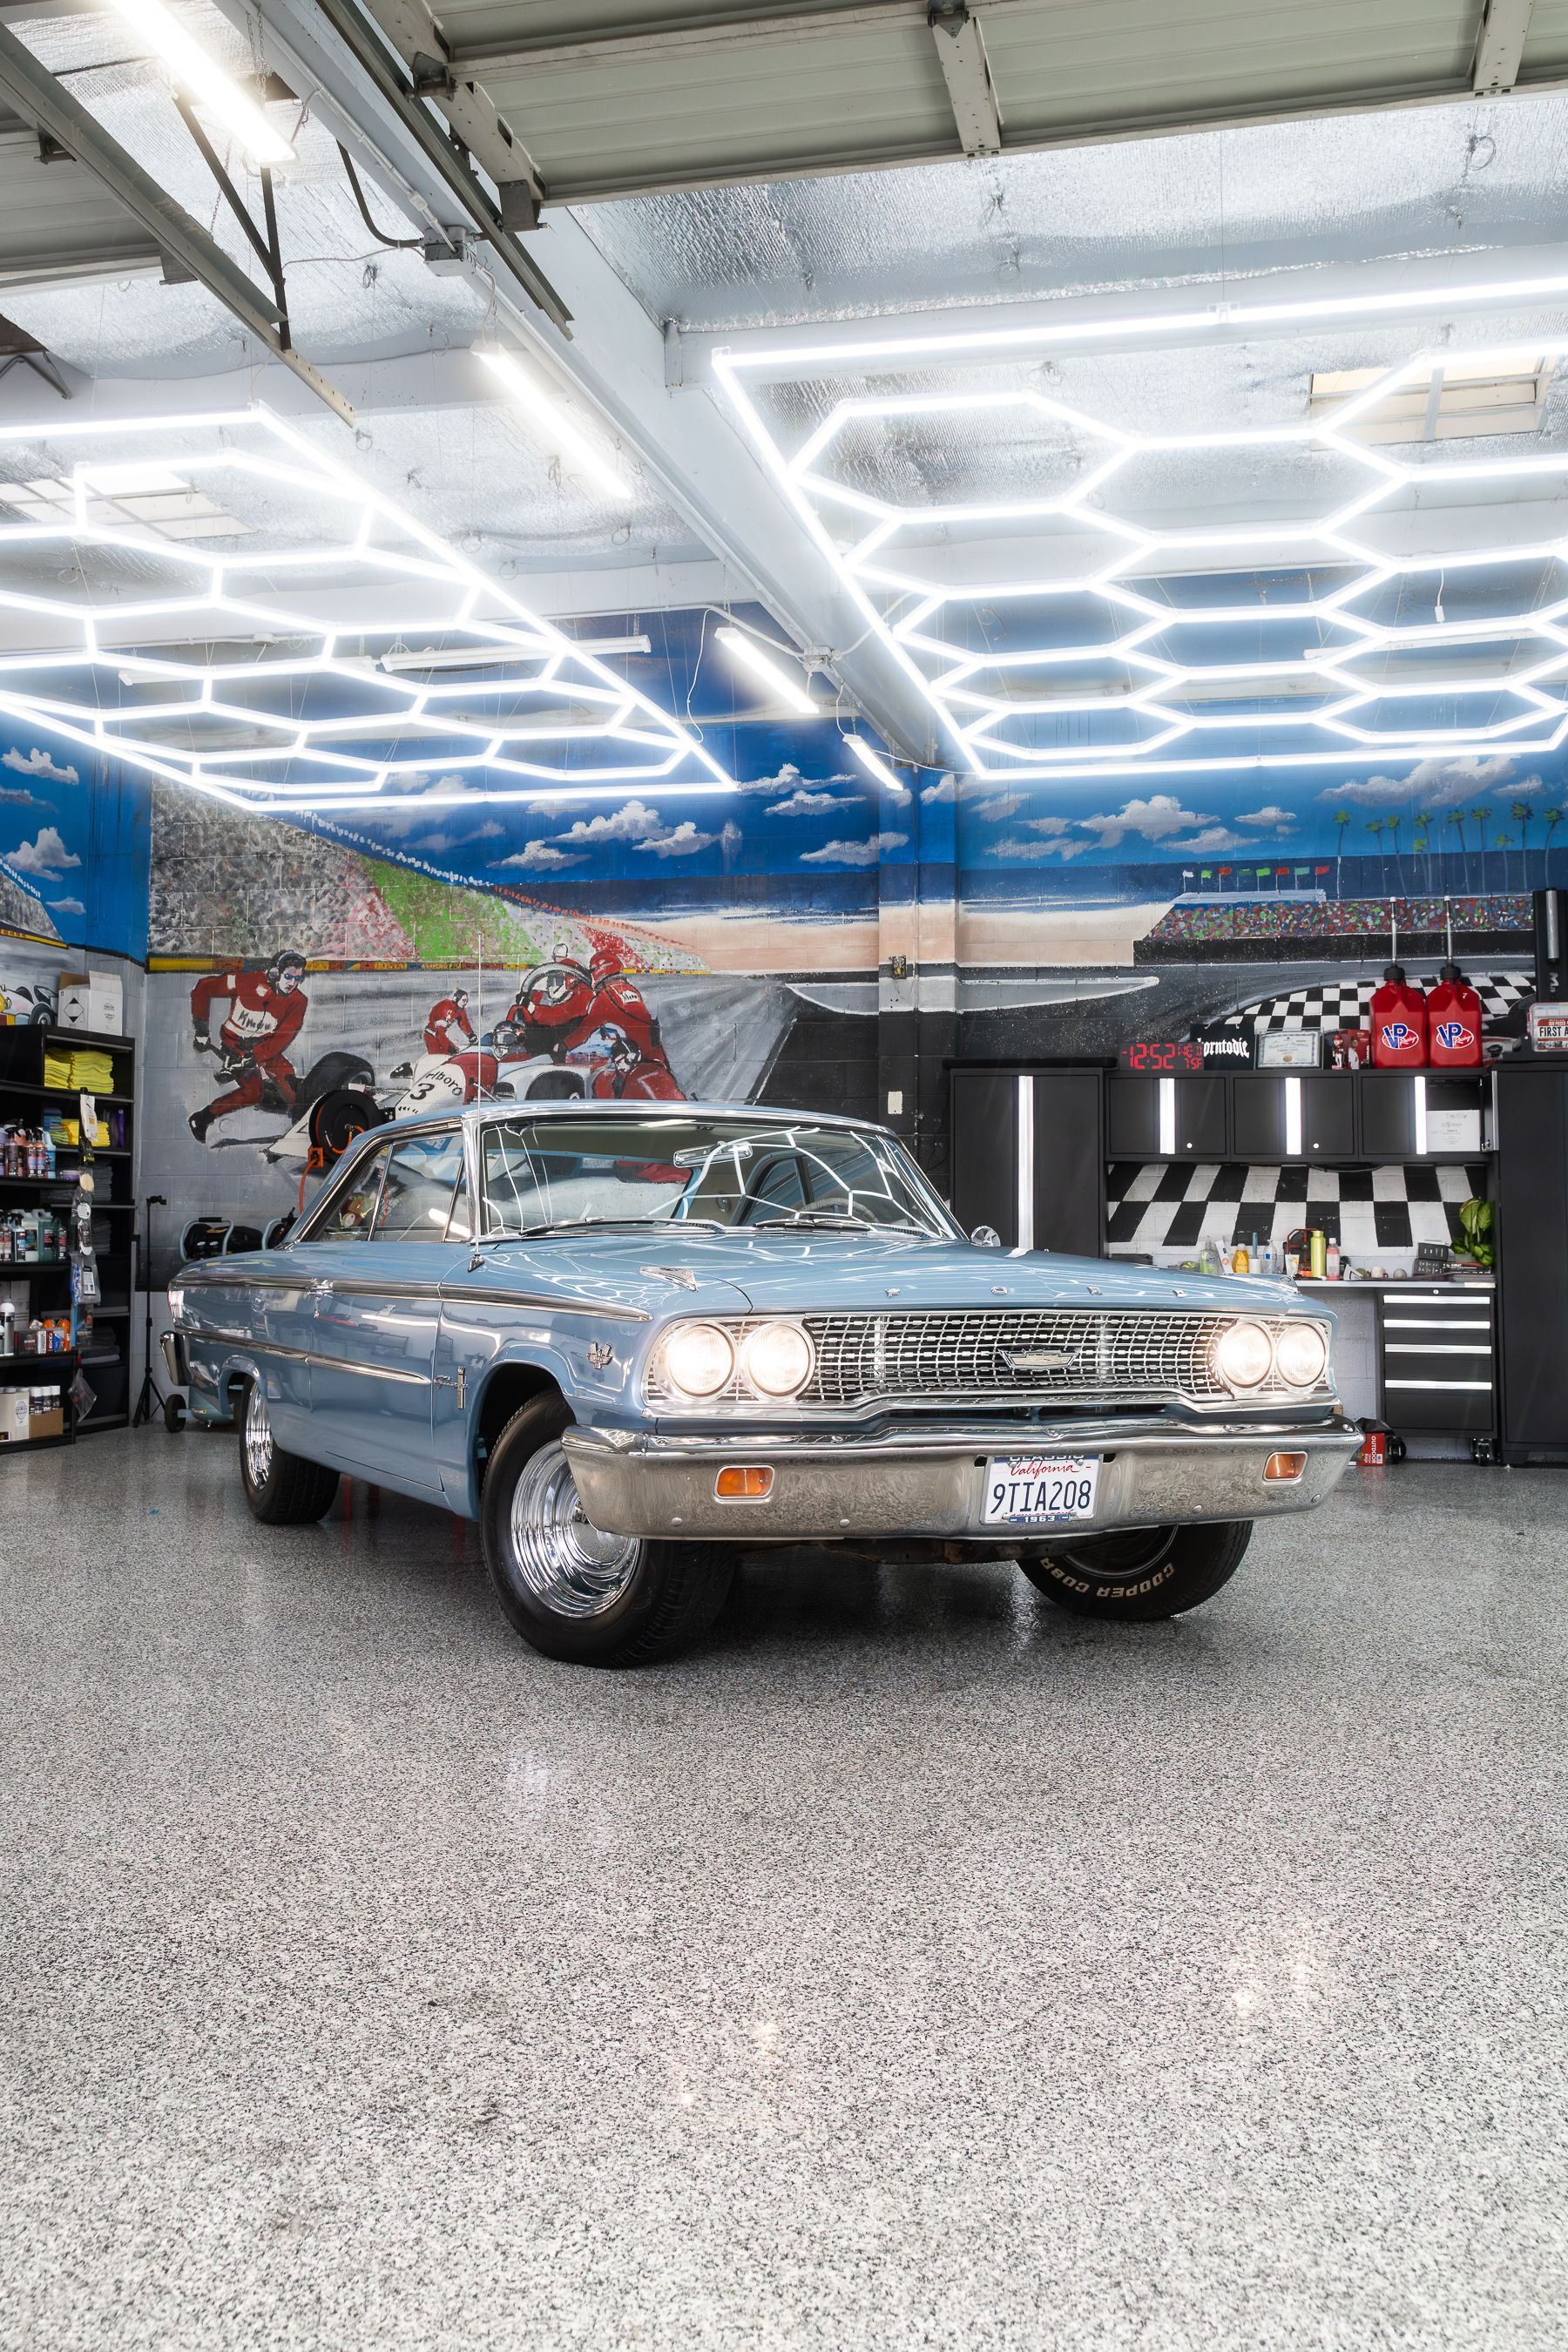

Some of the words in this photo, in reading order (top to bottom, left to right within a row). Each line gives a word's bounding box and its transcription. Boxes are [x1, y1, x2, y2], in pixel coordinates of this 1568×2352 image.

[1382, 1024, 1408, 1049] VP
[1399, 1035, 1417, 1045] Racing
[1436, 1023, 1463, 1048] VP
[1454, 1035, 1473, 1045] Racing
[1539, 1027, 1562, 1037] FIRST
[1130, 1043, 1175, 1069] 12:52
[1197, 1037, 1249, 1058] orntodie
[409, 1083, 435, 1100] 3
[1010, 1460, 1080, 1479] California
[990, 1480, 1092, 1514] 9TIA208
[1039, 1558, 1090, 1593] COBR
[1096, 1563, 1175, 1598] COOPER
